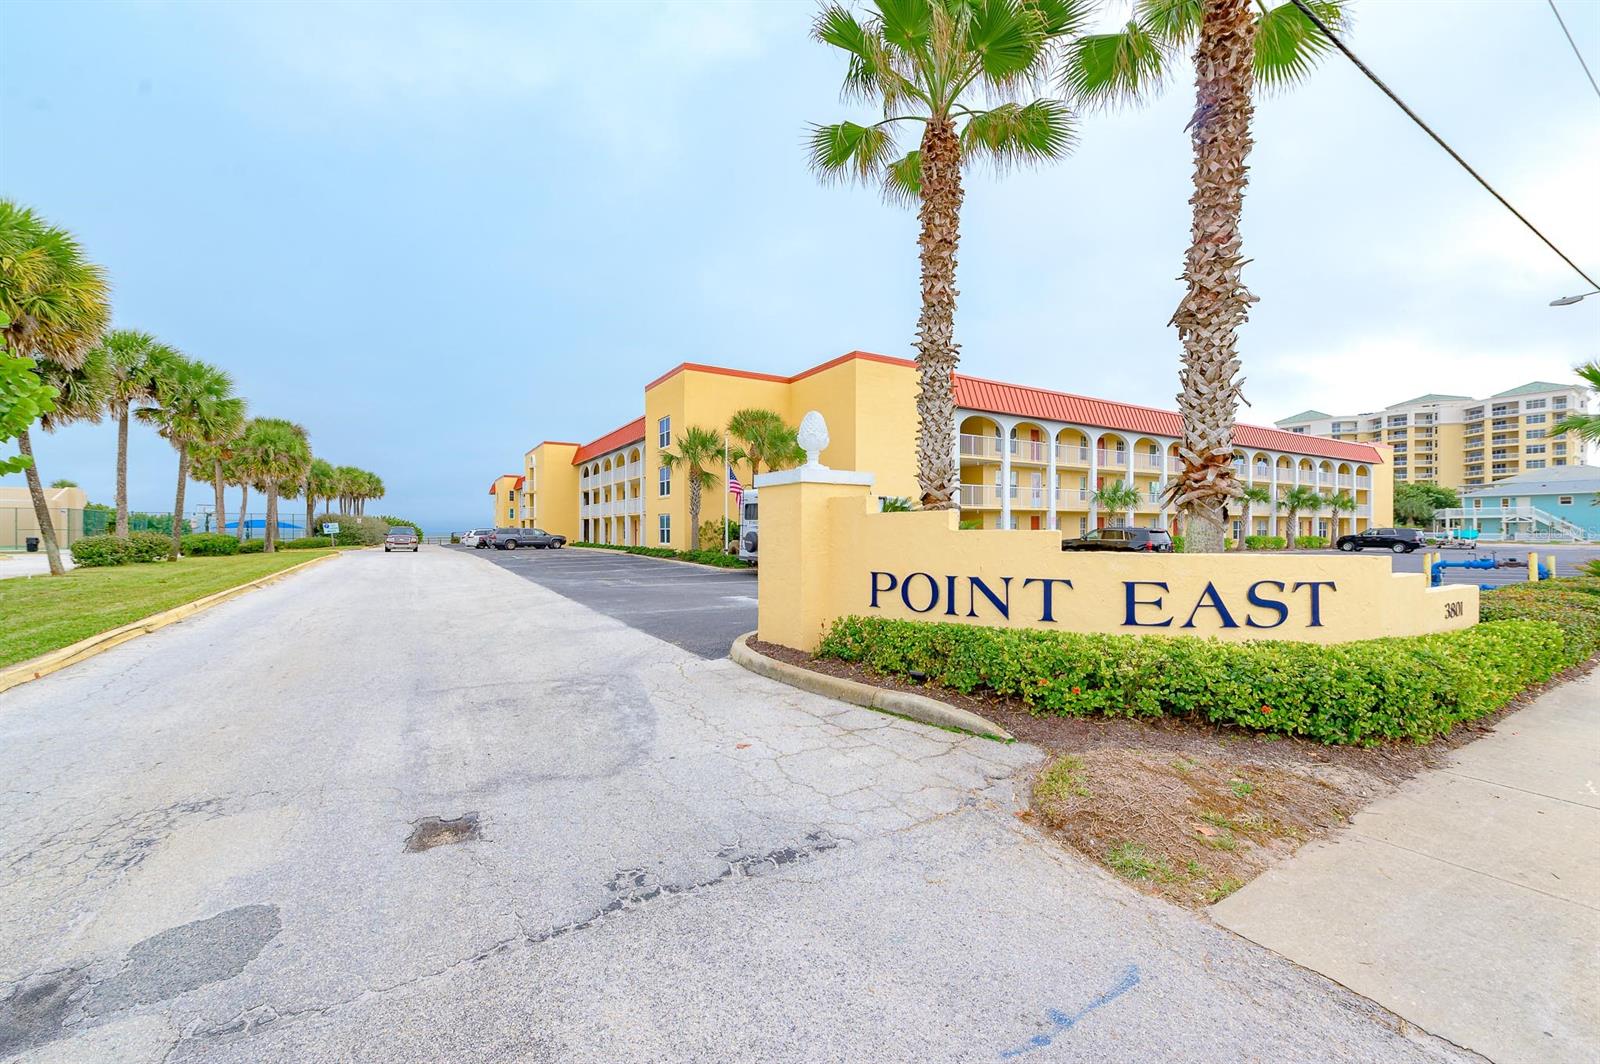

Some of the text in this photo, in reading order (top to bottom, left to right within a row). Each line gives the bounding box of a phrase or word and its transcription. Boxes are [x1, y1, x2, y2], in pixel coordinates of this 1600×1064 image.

[869, 571, 1337, 629] POINT EAST
[1443, 601, 1463, 620] 3801
